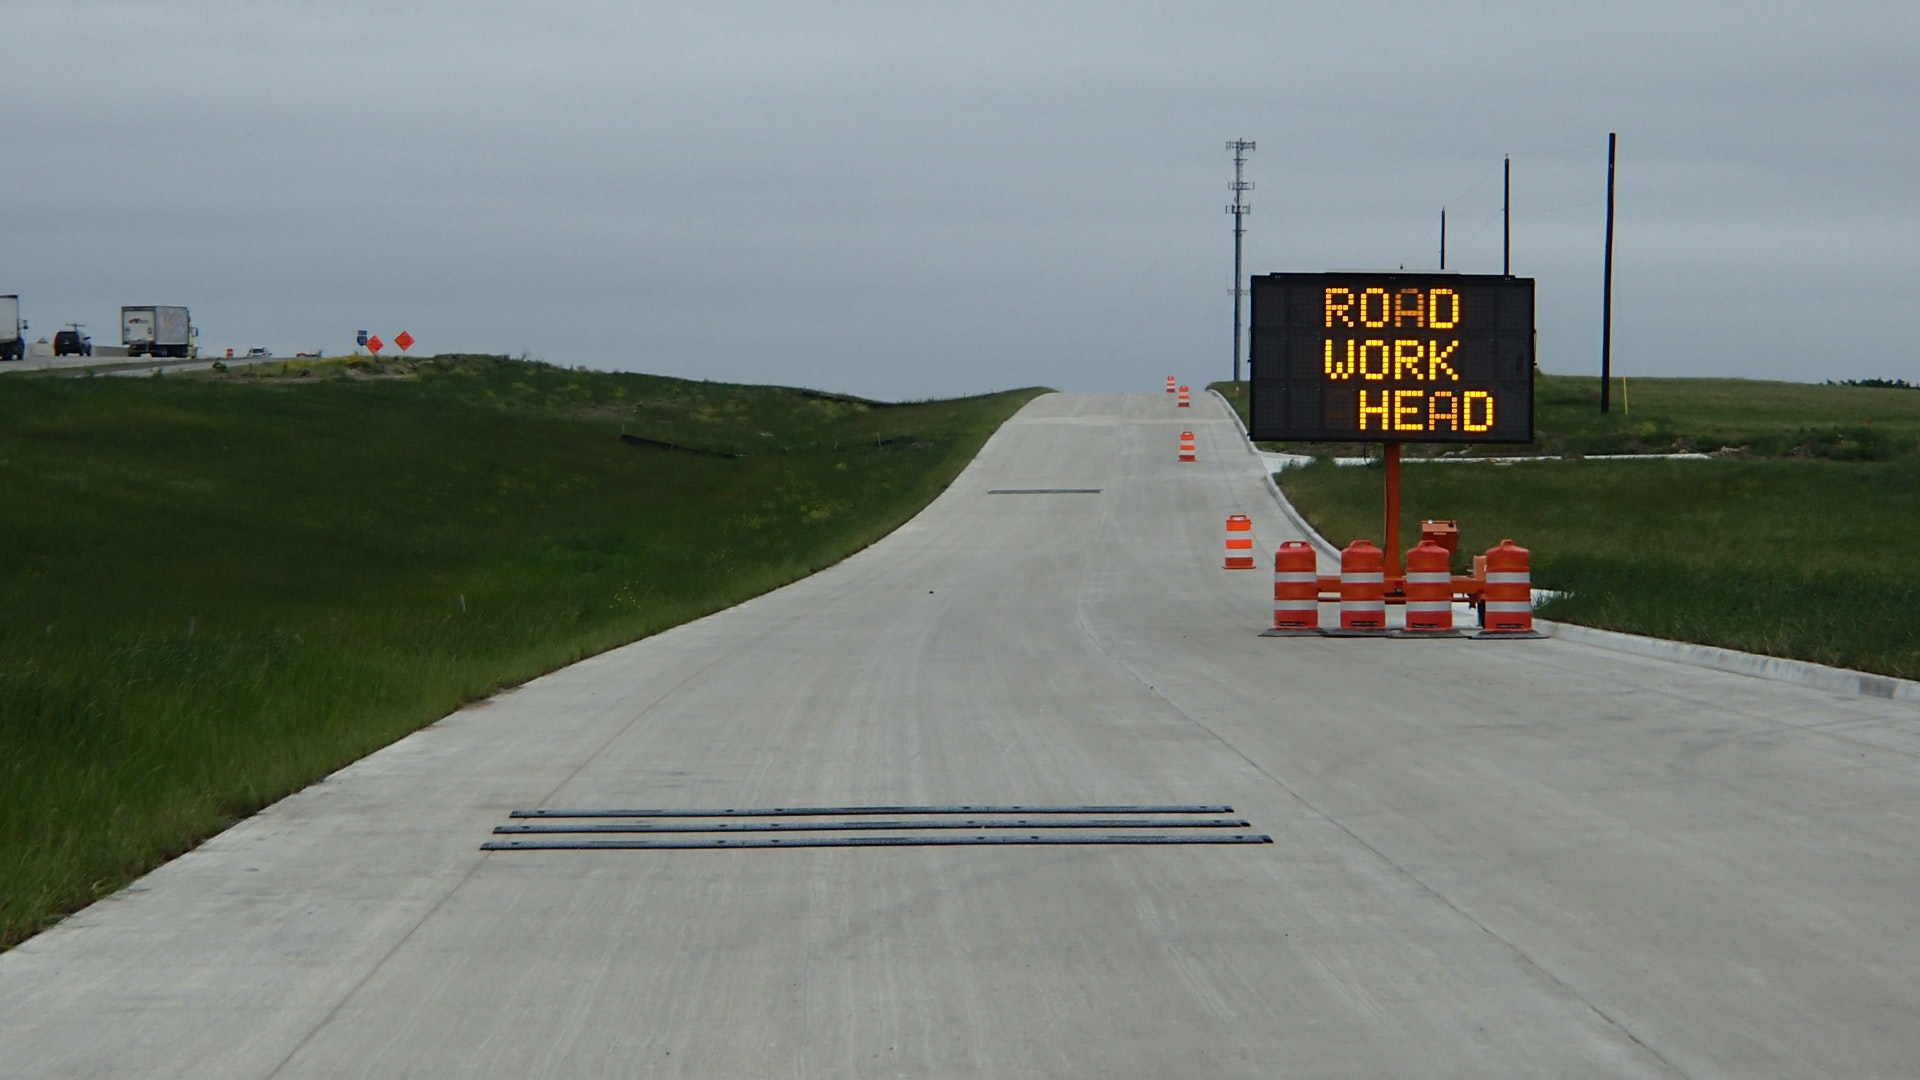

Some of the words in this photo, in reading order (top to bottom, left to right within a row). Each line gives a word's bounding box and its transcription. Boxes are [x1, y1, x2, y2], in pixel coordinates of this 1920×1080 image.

[1325, 288, 1459, 328] ROAD
[1324, 339, 1459, 380] WORK
[1359, 389, 1494, 432] HEAD
